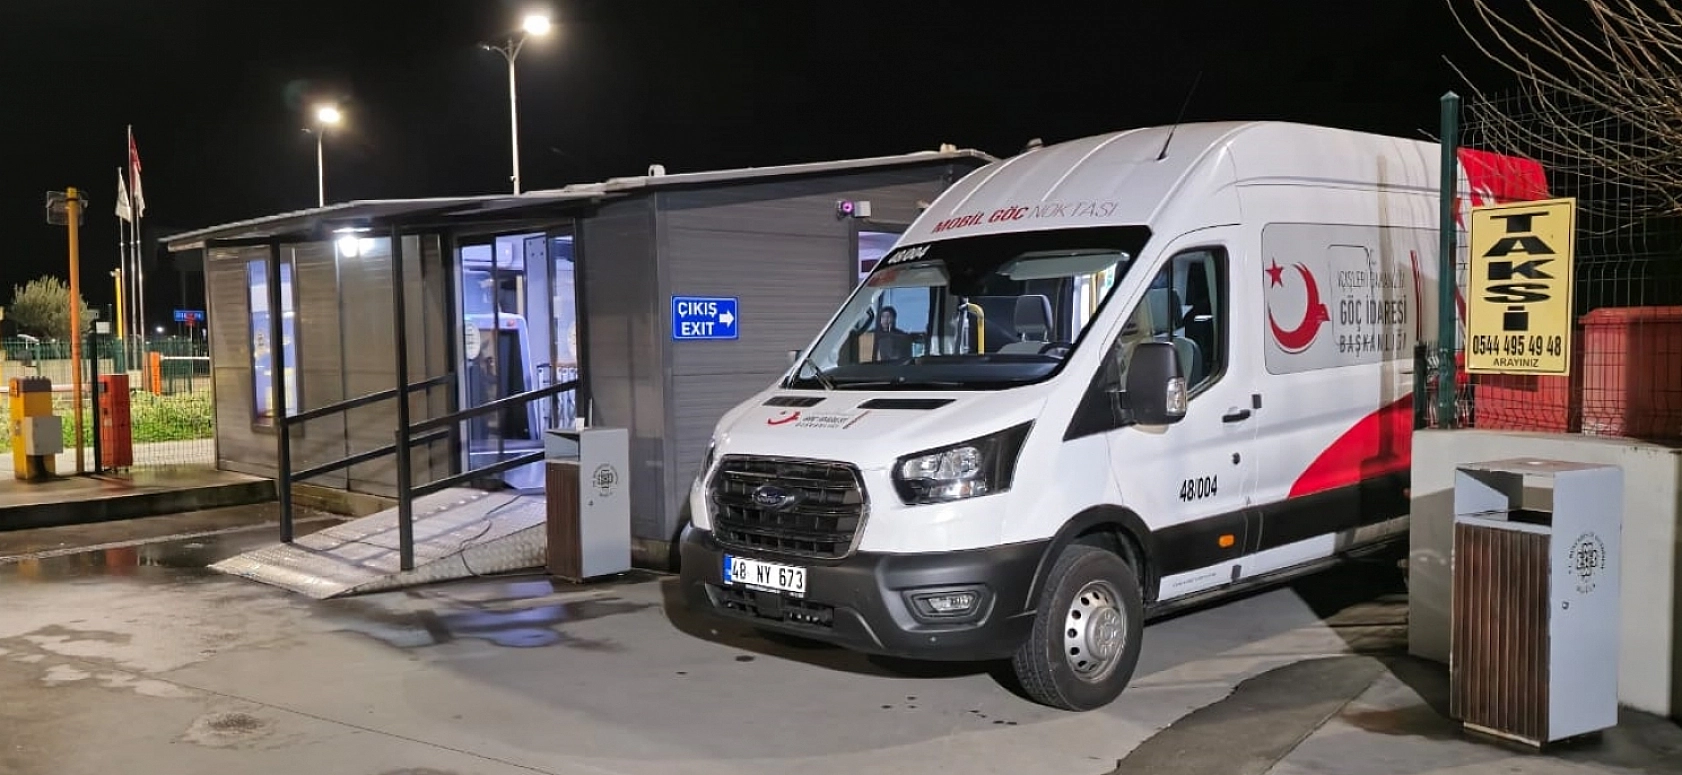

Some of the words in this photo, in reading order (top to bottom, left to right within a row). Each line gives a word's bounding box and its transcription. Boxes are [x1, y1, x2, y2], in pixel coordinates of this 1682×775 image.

[1482, 211, 1556, 331] TAKSİ
[678, 302, 718, 318] ÇIKIŞ
[1340, 294, 1362, 332] GÖÇ
[1366, 294, 1407, 326] İDARESİ
[681, 321, 715, 336] EXIT
[1472, 335, 1500, 356] 0544
[1503, 335, 1526, 357] 495
[1528, 335, 1544, 356] 49
[1546, 335, 1562, 357] 48
[1179, 475, 1218, 502] 48/004
[732, 560, 747, 580] 48
[756, 565, 771, 584] NY
[779, 568, 804, 590] 673
